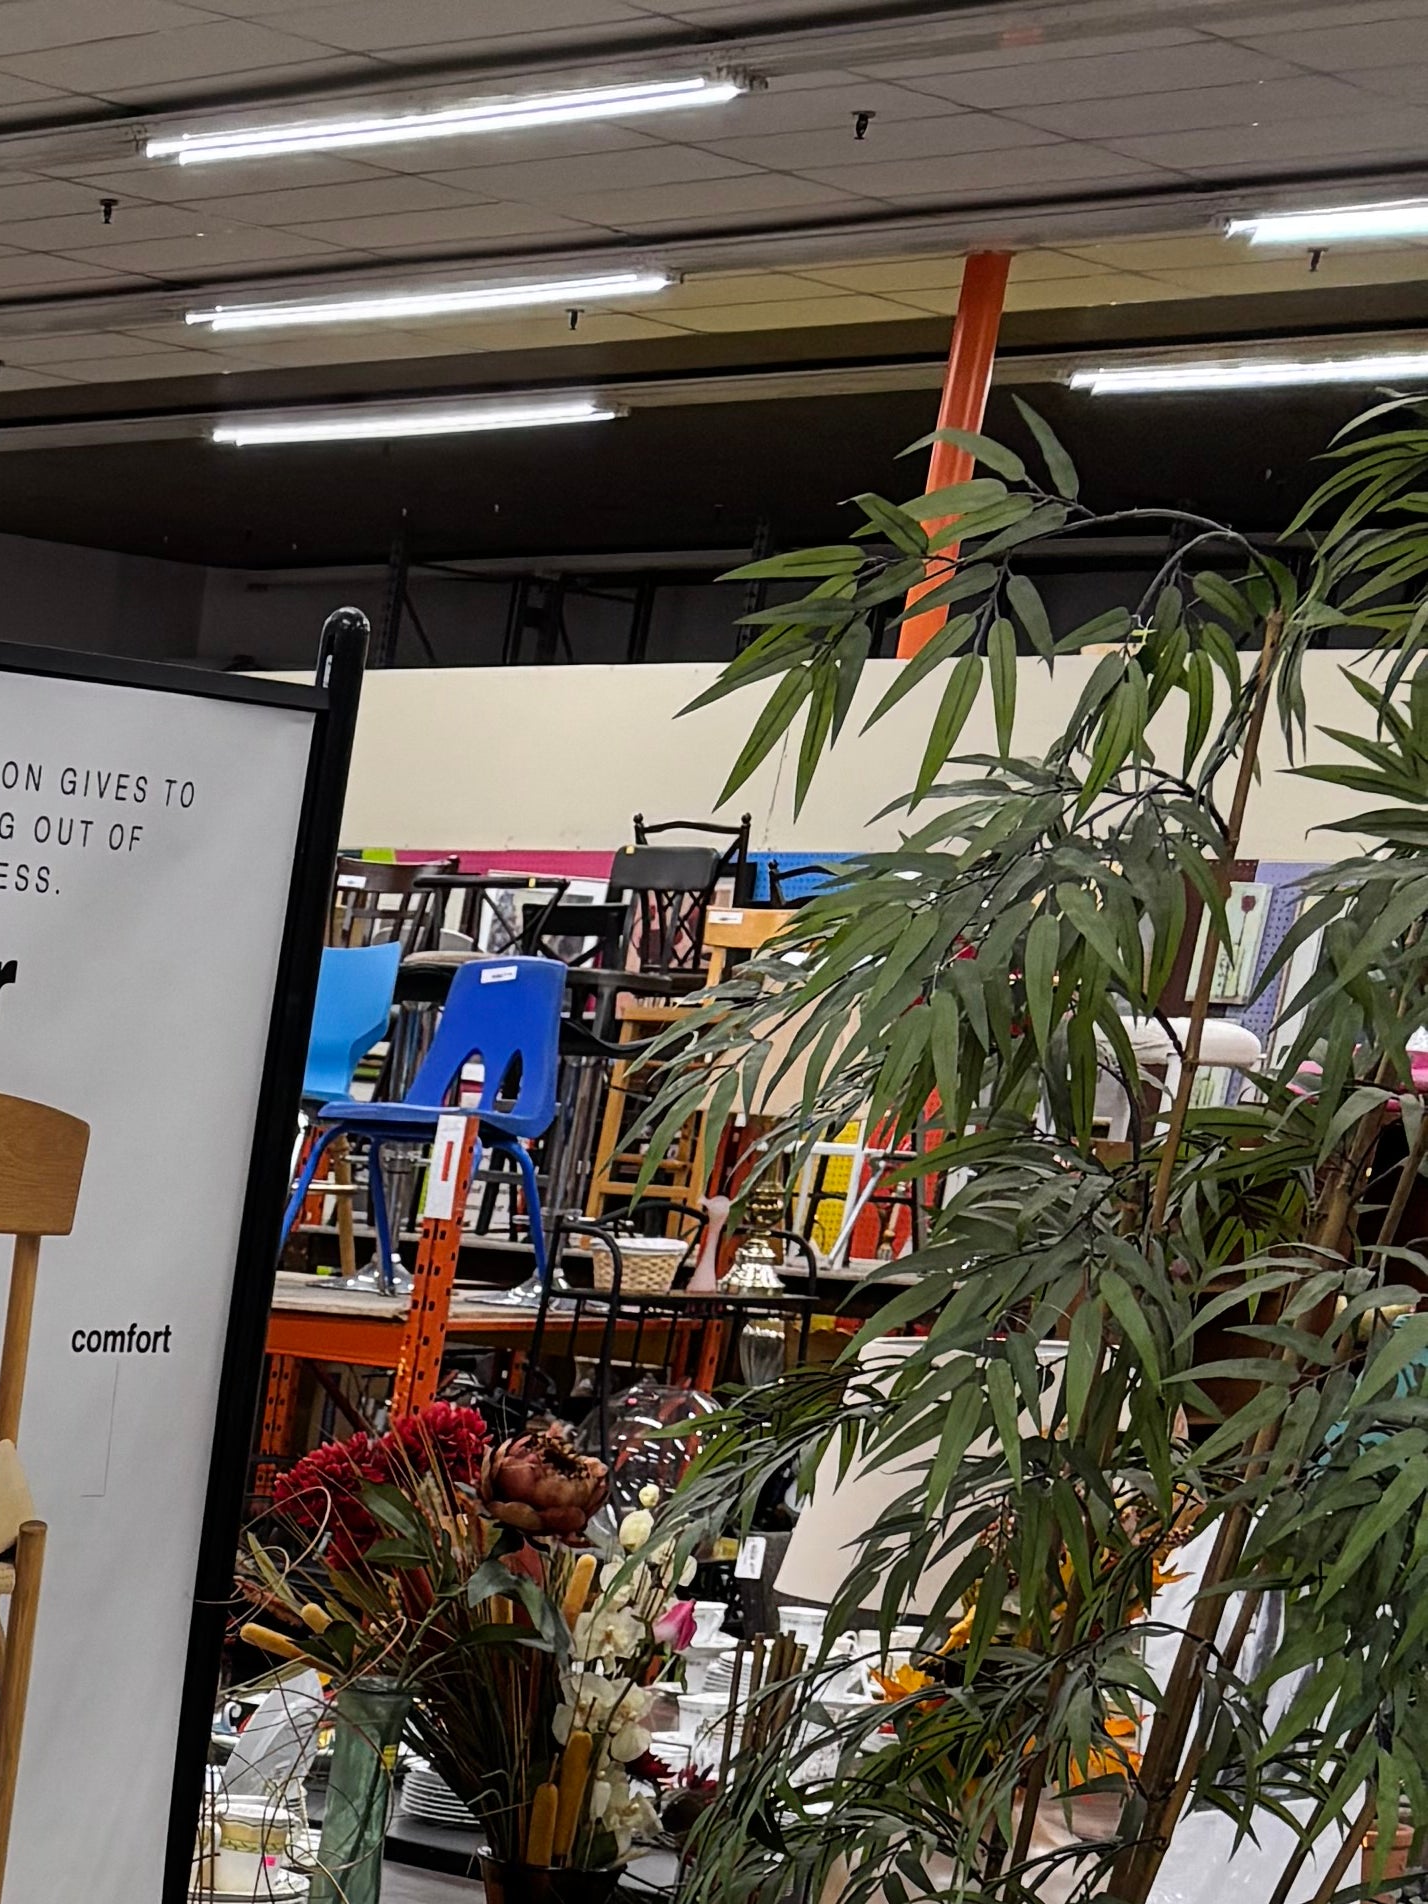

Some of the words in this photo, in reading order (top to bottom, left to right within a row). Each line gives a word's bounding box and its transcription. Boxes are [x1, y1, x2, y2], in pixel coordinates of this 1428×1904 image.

[60, 767, 148, 804] GIVES
[164, 778, 196, 809] TO
[33, 816, 94, 849] OUT
[108, 823, 144, 853] OF
[71, 1322, 172, 1354] comfort
